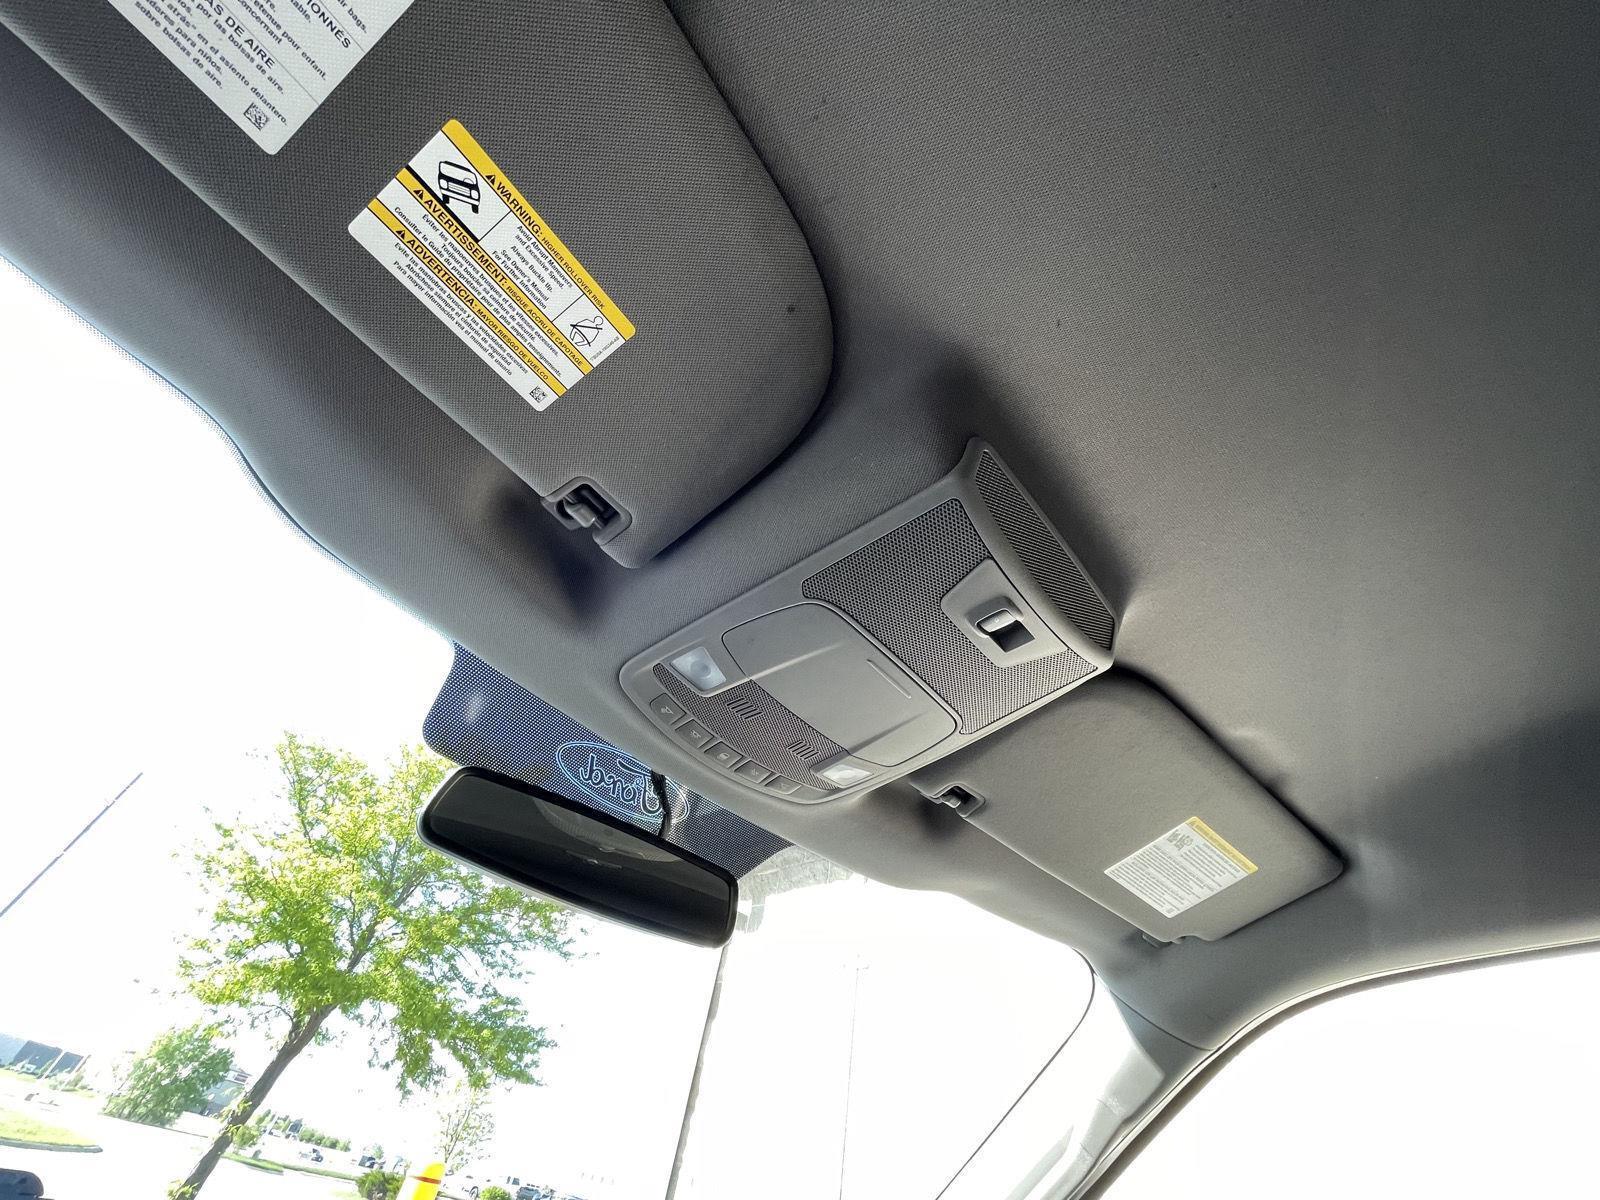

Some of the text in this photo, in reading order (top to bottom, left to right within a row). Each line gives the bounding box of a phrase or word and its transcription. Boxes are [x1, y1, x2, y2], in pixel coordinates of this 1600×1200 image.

[134, 0, 223, 89] sobre bolsas de aire.
[174, 26, 197, 48] para
[197, 48, 222, 75] niños.
[195, 2, 284, 95] por las bolsas de aire.
[224, 15, 245, 38] DE
[243, 38, 276, 69] AIRE
[252, 0, 326, 81] etenue pour enfant.
[347, 7, 367, 34] bags.
[197, 33, 209, 46] en
[209, 45, 220, 55] el
[219, 55, 250, 87] asiento
[250, 86, 287, 126] delantero.
[394, 206, 423, 236] Consulter
[421, 234, 429, 243] le
[428, 240, 445, 259] Guide
[443, 257, 453, 267] du
[450, 265, 482, 297] propriétaire
[480, 295, 494, 308] pour
[492, 307, 501, 315] de
[498, 314, 512, 326] plus
[510, 325, 528, 343] amples
[423, 199, 584, 367] AVERTISSEMENT: RISQUE ACCRU DE CAPOTAGE
[438, 231, 449, 243] les
[447, 241, 480, 275] manoeuvres
[478, 273, 503, 299] brusques
[501, 297, 509, 305] et
[507, 302, 517, 313] les
[515, 311, 536, 332] vitesses
[441, 243, 464, 269] Toujours
[463, 266, 484, 288] boucler
[482, 287, 491, 295] sa
[489, 294, 510, 316] ceinture
[508, 314, 517, 322] de
[491, 250, 547, 310] For Further Information
[496, 181, 543, 238] WARNING:
[541, 236, 565, 263] HIGHER
[562, 261, 593, 296] ROLLOVER
[591, 294, 606, 310] RISK
[500, 249, 550, 302] See Owner's Manual
[510, 245, 553, 293] Always Buckle Up.
[514, 234, 565, 290] and Excessive Speed.
[516, 225, 573, 289] Avoid Abrupt Maneuvers
[393, 260, 407, 276] Para
[406, 274, 426, 292] mayor
[424, 290, 456, 322] información
[454, 320, 465, 331] vea
[469, 334, 490, 353] manual
[487, 352, 495, 360] de
[494, 358, 513, 376] usuario
[394, 242, 410, 258] Evite
[408, 256, 419, 267] las
[418, 266, 447, 295] maniobras
[446, 292, 468, 315] bruscas
[470, 316, 480, 327] las
[478, 325, 507, 354] velocidades
[505, 352, 529, 375] excesivas
[406, 238, 549, 381] ADVERTENCIA: MAYOR RIESGO DE VUELCO
[433, 291, 456, 313] siempre
[480, 336, 489, 344] de
[487, 343, 512, 367] seguridad
